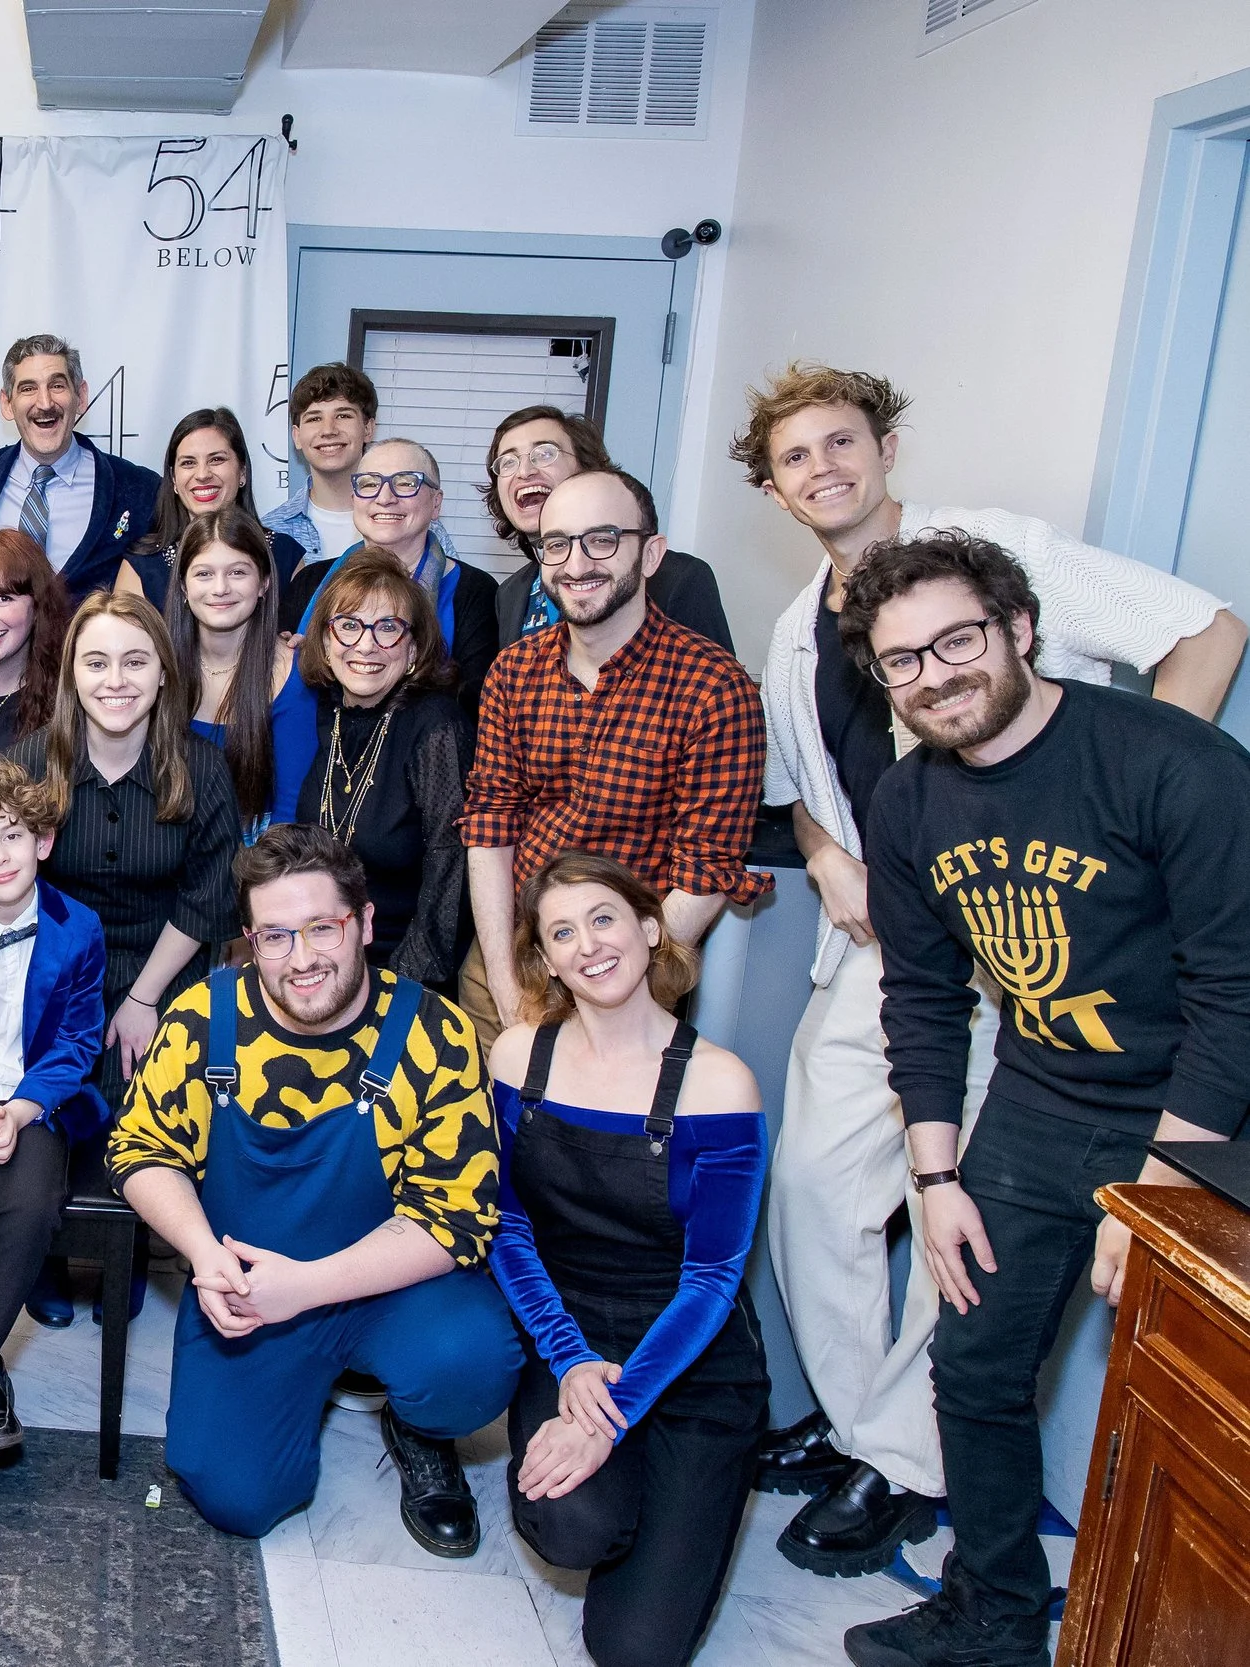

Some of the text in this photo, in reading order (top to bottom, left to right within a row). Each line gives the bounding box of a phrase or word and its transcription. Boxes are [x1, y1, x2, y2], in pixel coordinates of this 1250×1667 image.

[143, 137, 272, 240] 54
[156, 246, 257, 267] BELOW
[930, 837, 1107, 895] LET'S GET
